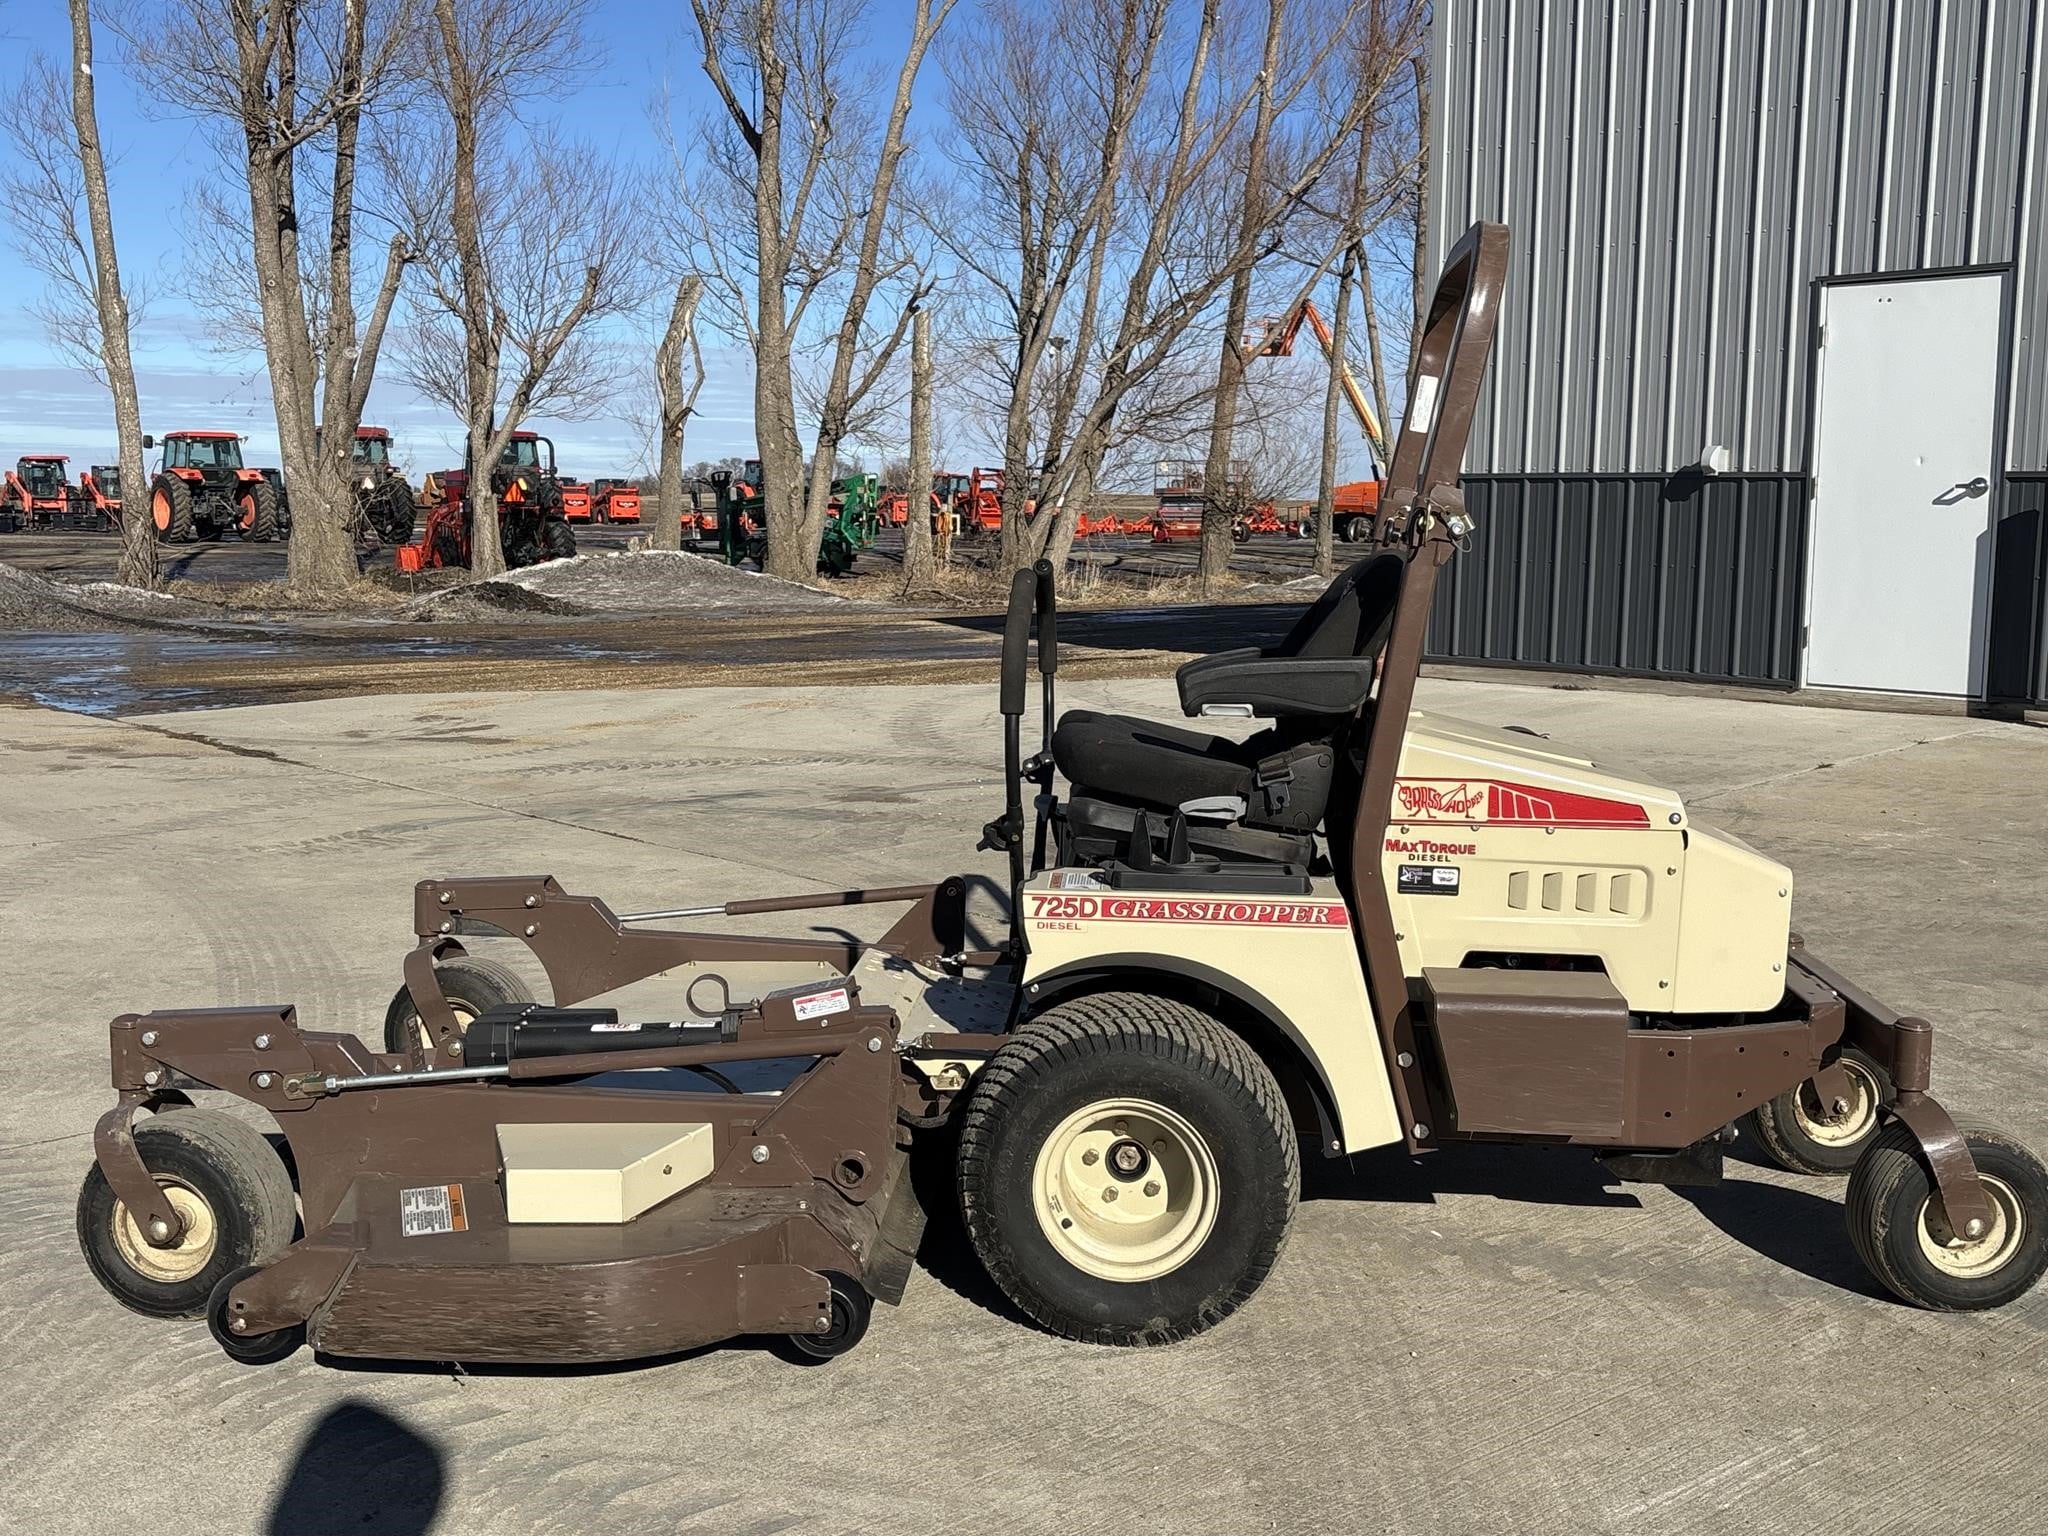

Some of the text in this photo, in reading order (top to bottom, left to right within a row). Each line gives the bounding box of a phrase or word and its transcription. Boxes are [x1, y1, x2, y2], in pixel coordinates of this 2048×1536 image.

[1408, 853, 1451, 862] DIESEL
[1032, 896, 1329, 924] 725D GRASSHOPPER
[1037, 921, 1081, 931] DIESEL
